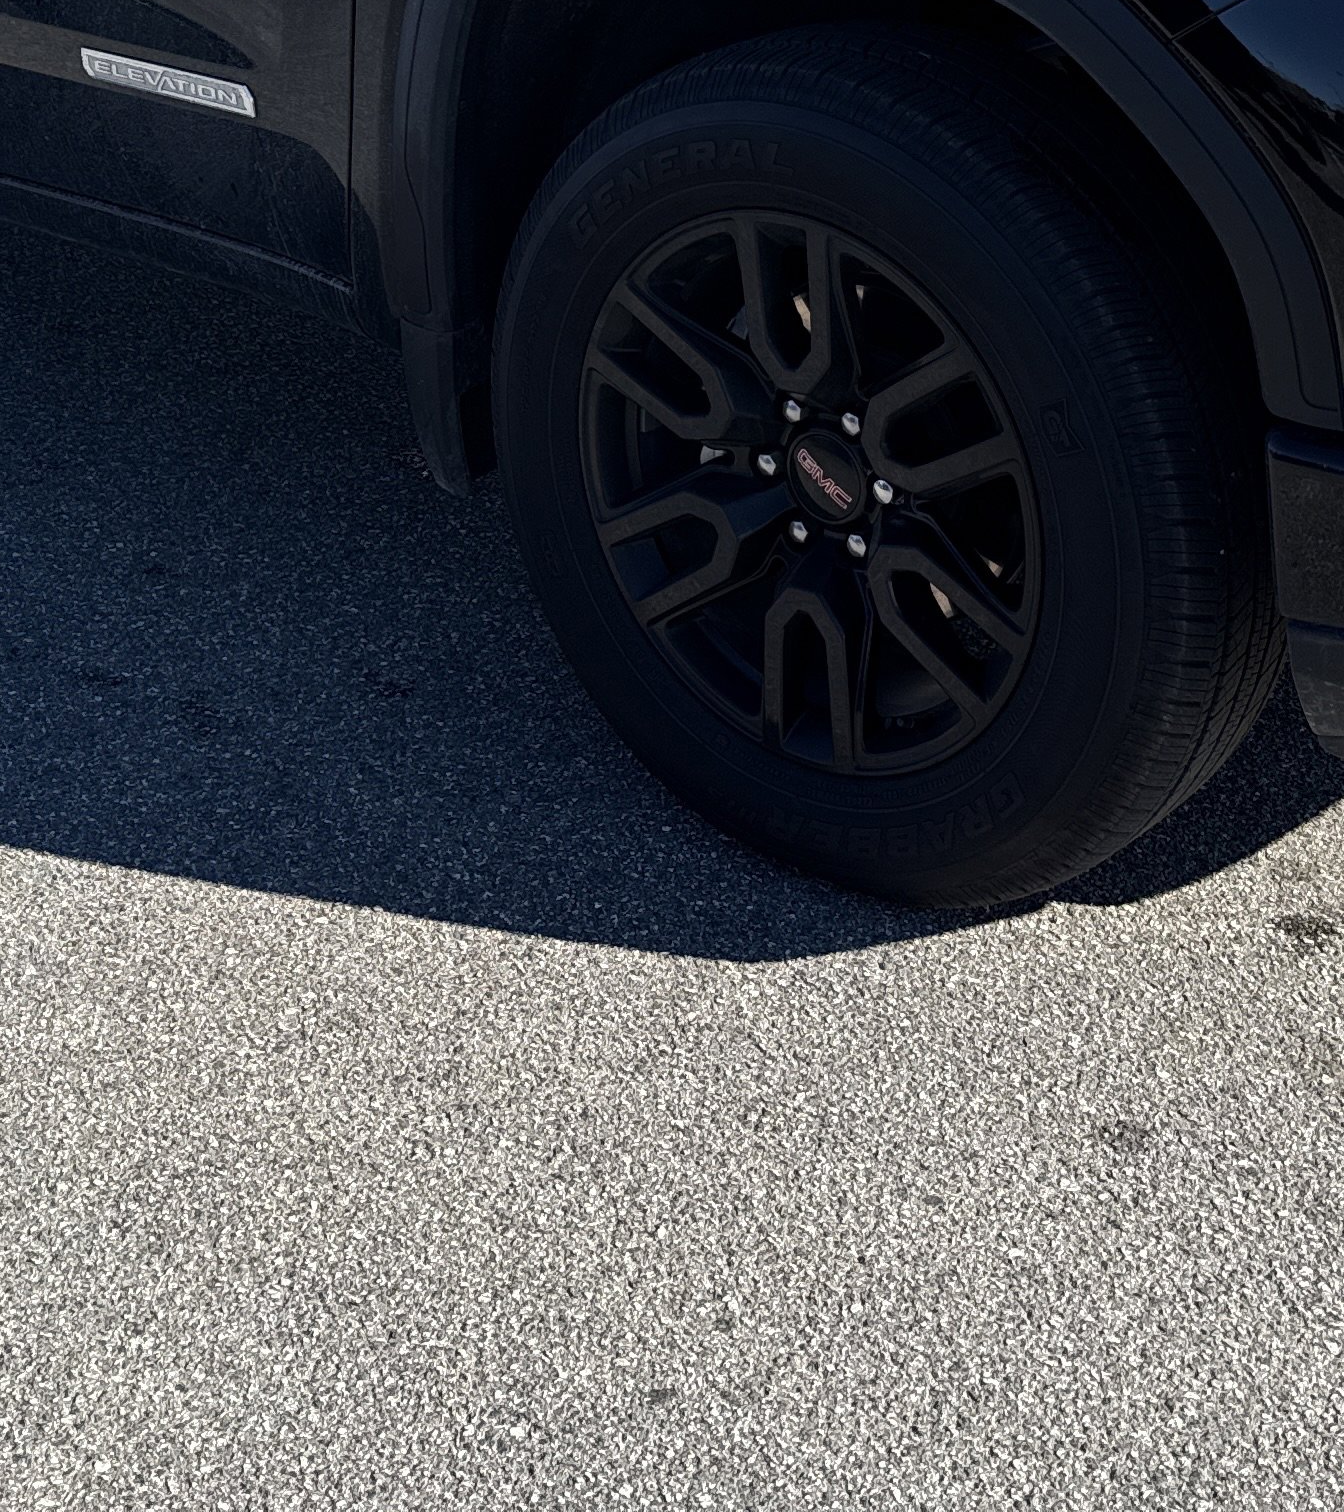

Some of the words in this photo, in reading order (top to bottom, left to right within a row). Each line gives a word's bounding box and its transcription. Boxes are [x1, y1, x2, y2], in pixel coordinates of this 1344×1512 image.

[94, 60, 238, 105] ELEVATION
[570, 138, 794, 249] GENERAL
[797, 448, 852, 509] GMC
